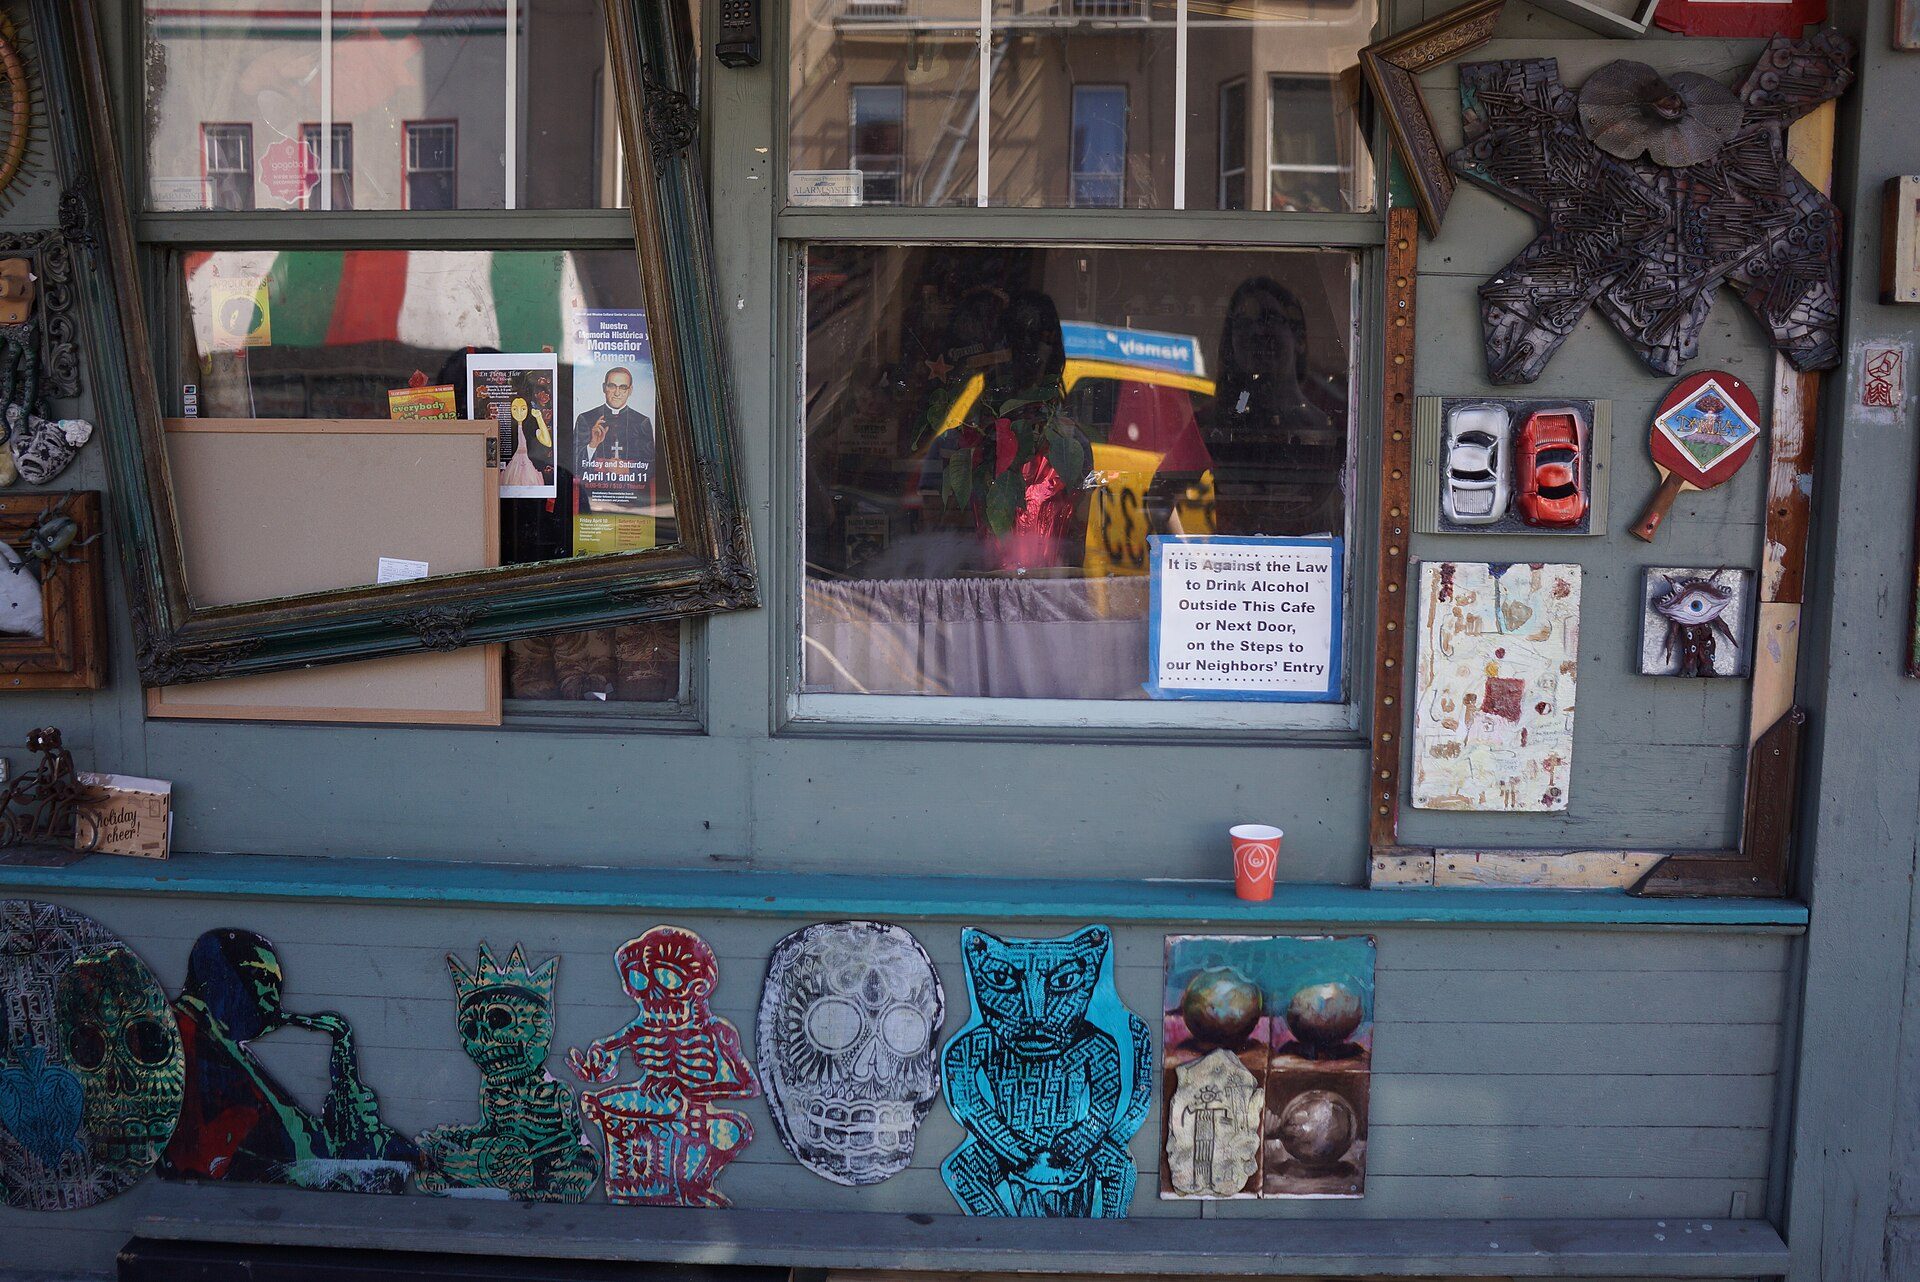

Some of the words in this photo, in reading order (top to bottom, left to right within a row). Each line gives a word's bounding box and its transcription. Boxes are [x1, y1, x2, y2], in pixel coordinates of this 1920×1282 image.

[588, 340, 641, 350] Monseñor
[594, 352, 635, 362] Romero
[393, 402, 444, 412] everybody
[582, 460, 603, 468] Friday
[619, 461, 648, 470] Saturday
[582, 472, 603, 482] April
[606, 472, 616, 481] 10
[619, 472, 634, 482] and
[638, 473, 646, 481] 11
[1168, 559, 1179, 570] It
[1185, 559, 1197, 570] is
[1203, 559, 1261, 573] Against
[1266, 561, 1290, 572] the
[1296, 562, 1328, 573] Law
[1186, 580, 1200, 590] to
[1206, 580, 1246, 592] Drink
[1252, 581, 1309, 593] Alcohol
[1179, 599, 1237, 611] Outside
[1242, 601, 1275, 612] This
[1281, 602, 1316, 613] Cafe
[1196, 622, 1210, 630] or
[1216, 620, 1251, 632] Next
[1257, 621, 1296, 634] Door,
[1187, 642, 1204, 651] on
[1210, 641, 1234, 651] the
[1240, 641, 1283, 654] Steps
[1289, 642, 1304, 653] to
[1166, 661, 1190, 670] our
[1283, 662, 1324, 675] Entry
[98, 807, 137, 828] holiday
[107, 822, 140, 843] cheer!
